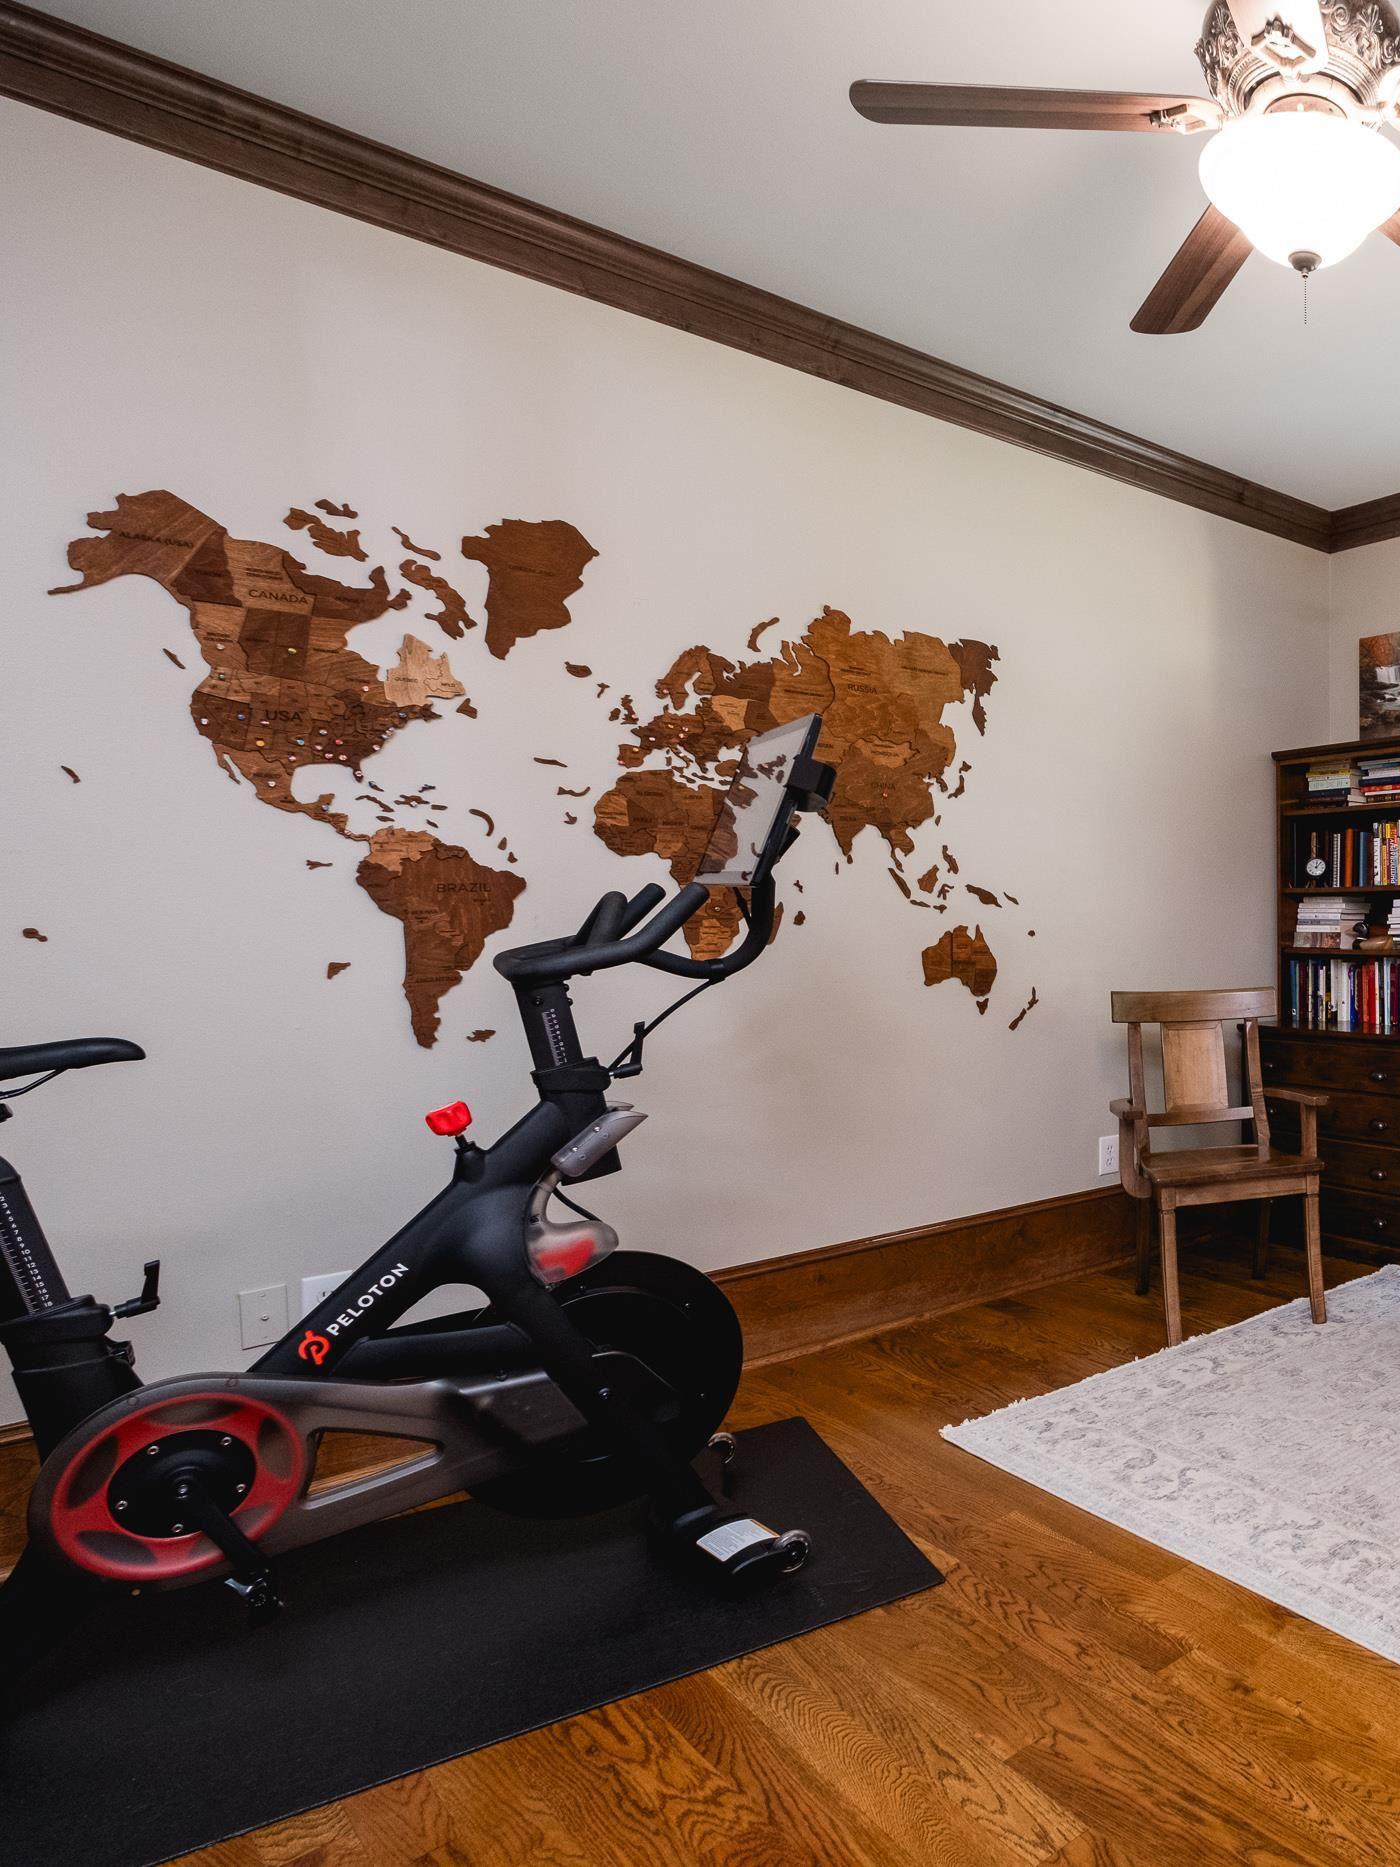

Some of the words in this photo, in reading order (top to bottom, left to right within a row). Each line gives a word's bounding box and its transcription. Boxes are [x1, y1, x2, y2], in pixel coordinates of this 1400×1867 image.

[248, 589, 308, 605] CANADA
[847, 683, 879, 695] RUSSIA
[265, 709, 305, 723] USA
[435, 882, 492, 894] BRAZIL
[326, 1262, 410, 1336] PELOTON
